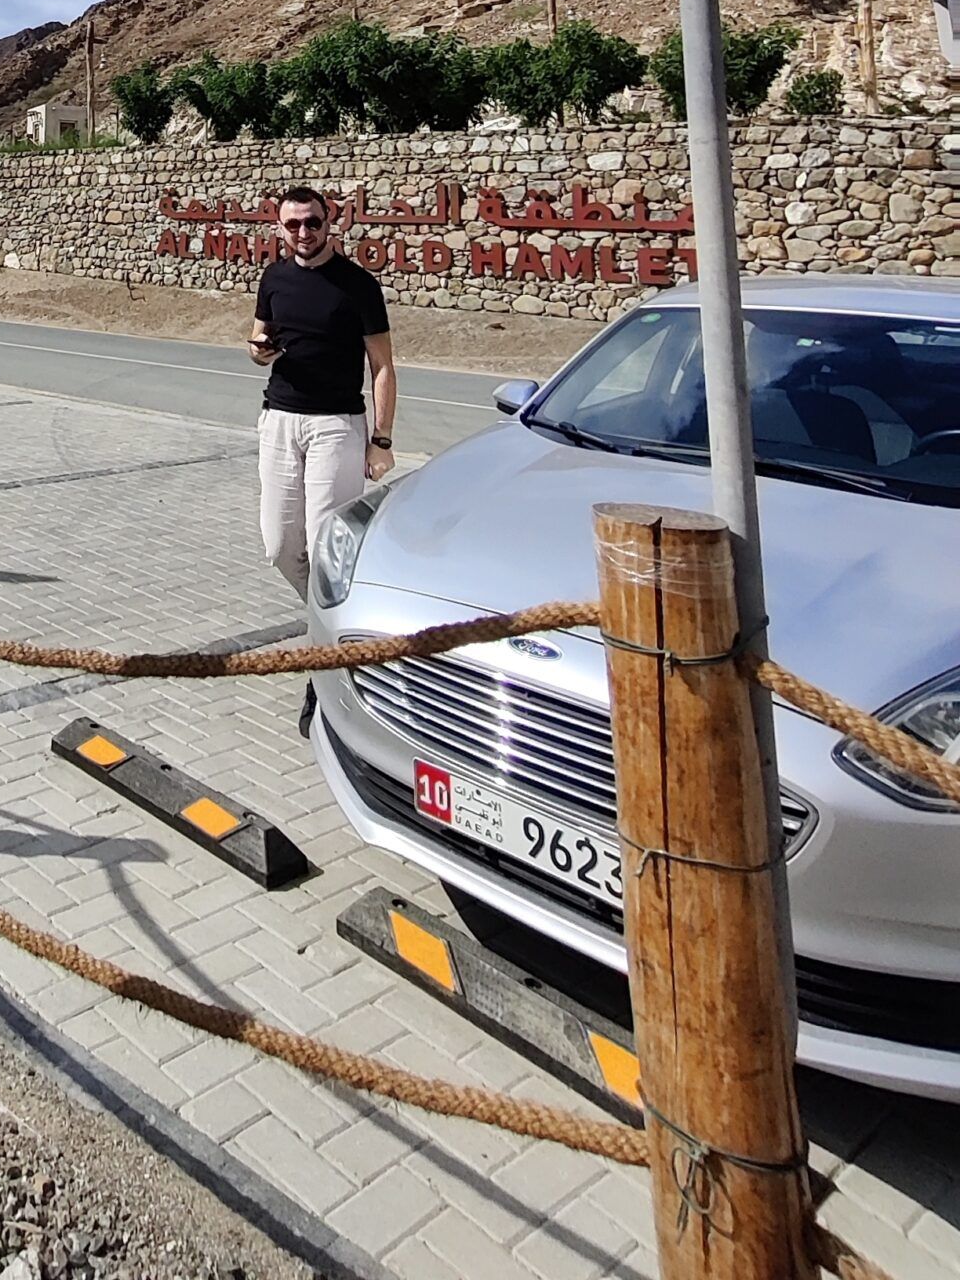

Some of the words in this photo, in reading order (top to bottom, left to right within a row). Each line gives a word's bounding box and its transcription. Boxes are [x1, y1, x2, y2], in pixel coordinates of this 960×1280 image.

[158, 187, 280, 231] قديمة
[156, 227, 195, 259] AL
[203, 231, 345, 263] NAH
[356, 238, 453, 274] OLD
[470, 241, 699, 285] HAMLET
[418, 773, 449, 812] 10
[522, 816, 623, 900] 9623
